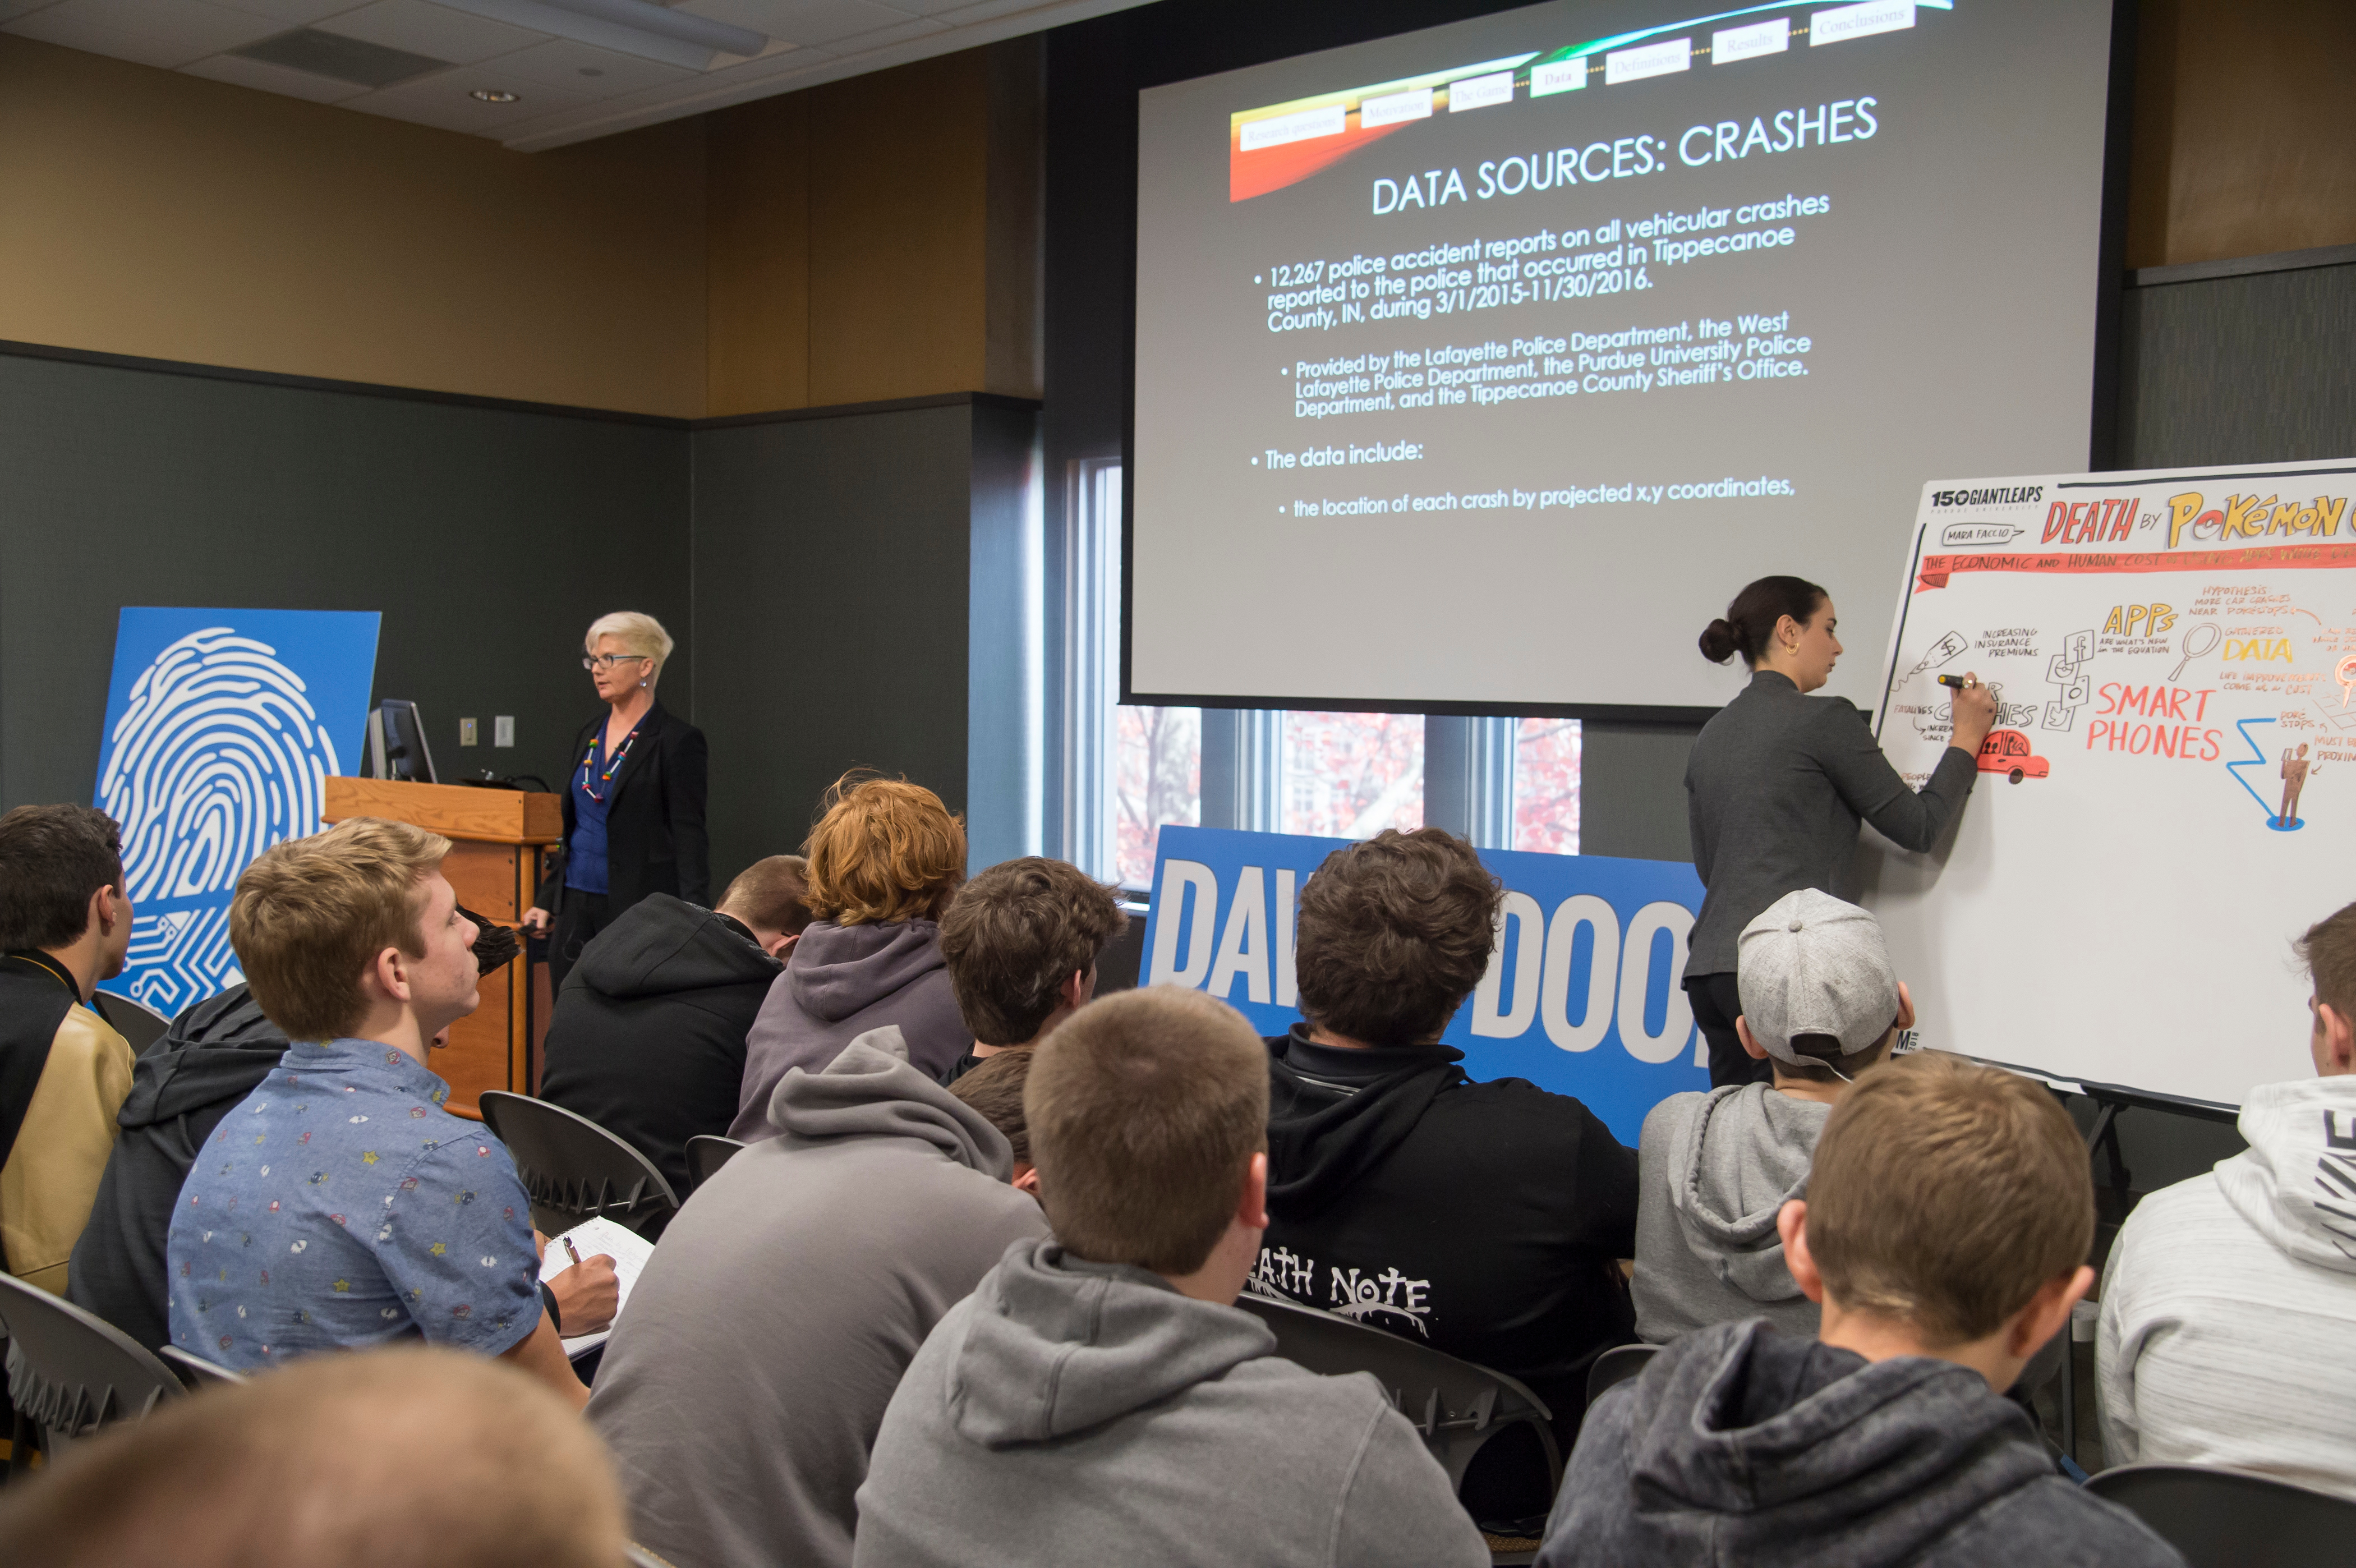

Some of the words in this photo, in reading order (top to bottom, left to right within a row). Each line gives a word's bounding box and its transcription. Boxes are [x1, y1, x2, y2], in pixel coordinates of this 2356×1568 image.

[1819, 7, 1905, 36] Conclusions
[1727, 33, 1774, 53] Results
[1613, 49, 1681, 75] Definitions
[1544, 70, 1572, 86] Data
[1454, 89, 1473, 104] The
[1476, 84, 1508, 100] Game
[1369, 100, 1424, 119] Motivation
[1248, 125, 1290, 142] Research
[1291, 116, 1336, 135] questions
[1373, 167, 1467, 215] DATA
[1477, 135, 1666, 199] SOURCES:
[1679, 96, 1878, 167] CRASHES
[1271, 260, 1324, 287] 12,267
[1329, 255, 1386, 283] police
[1391, 238, 1481, 270] accident
[1485, 229, 1556, 256] reports
[1561, 228, 1590, 248] on
[1595, 218, 1621, 243] all
[1626, 206, 1732, 238] vehicular
[1736, 194, 1830, 224] crashes
[1268, 280, 1346, 312] reported
[1350, 279, 1369, 299] to
[1374, 275, 1405, 297] the
[1411, 267, 1472, 297] police
[1478, 259, 1519, 284] that
[1524, 244, 1623, 279] occurred
[1628, 242, 1648, 265] in
[1653, 227, 1795, 265] Tippecanoe
[1268, 307, 1337, 332] County,
[1342, 301, 1365, 323] IN,
[1370, 296, 1431, 320] during
[1435, 266, 1654, 314] 3/1/2015-11/30/2016.
[1296, 354, 1365, 379] Provided
[1369, 353, 1389, 374] by
[1393, 350, 1421, 369] the
[1425, 341, 1508, 366] Lafayette
[1512, 335, 1567, 357] Police
[1571, 320, 1693, 353] Department,
[1699, 318, 1732, 338] the
[1738, 310, 1789, 335] West
[1296, 377, 1370, 399] Lafayette
[1374, 371, 1423, 391] Police
[1428, 358, 1538, 388] Department,
[1544, 356, 1574, 375] the
[1579, 351, 1646, 373] Purdue
[1650, 339, 1742, 364] University
[1746, 334, 1812, 357] Police
[1295, 391, 1395, 420] Department,
[1399, 388, 1434, 408] and
[1438, 384, 1466, 406] the
[1470, 379, 1579, 406] Tippecanoe
[1582, 369, 1653, 392] County
[1657, 362, 1732, 387] Sheriff's
[1737, 357, 1809, 380] Office.
[1265, 449, 1296, 470] The
[1300, 445, 1345, 468] data
[1349, 439, 1424, 465] include:
[1294, 499, 1319, 517] the
[1322, 496, 1388, 516] location
[1392, 493, 1409, 513] of
[1412, 491, 1457, 512] each
[1461, 489, 1509, 510] crash
[1512, 488, 1536, 510] by
[1540, 482, 1632, 509] projected
[1636, 485, 1664, 504] x,y
[1667, 475, 1796, 500] coordinates,
[2041, 498, 2140, 544] DEATH
[2139, 513, 2161, 530] BY
[1947, 530, 1972, 541] MARA
[1976, 528, 2009, 538] FACCIO
[1925, 557, 1945, 571] THE
[1952, 555, 2032, 571] ECONOMIC
[2037, 559, 2060, 568] AND
[2068, 554, 2117, 568] HUMAN
[2124, 554, 2161, 566] COST
[2240, 548, 2275, 563] APPS
[1975, 638, 2031, 649] INSURANCE
[1982, 628, 2037, 639] INCREASING
[2225, 627, 2284, 636] GATHERED
[1989, 649, 2039, 657] PREMIUMS
[2128, 646, 2169, 654] EQUATION
[2222, 638, 2293, 663] DATA
[2220, 671, 2238, 679] LIFE
[2096, 682, 2216, 722] SMART
[2285, 684, 2312, 695] COST
[2280, 720, 2314, 730] STOPS
[2087, 720, 2223, 761] PHONES
[2314, 735, 2343, 746] MUST
[1471, 891, 1709, 1068] DOO
[1249, 1247, 1314, 1295] ATH
[1330, 1267, 1430, 1313] NOTE
